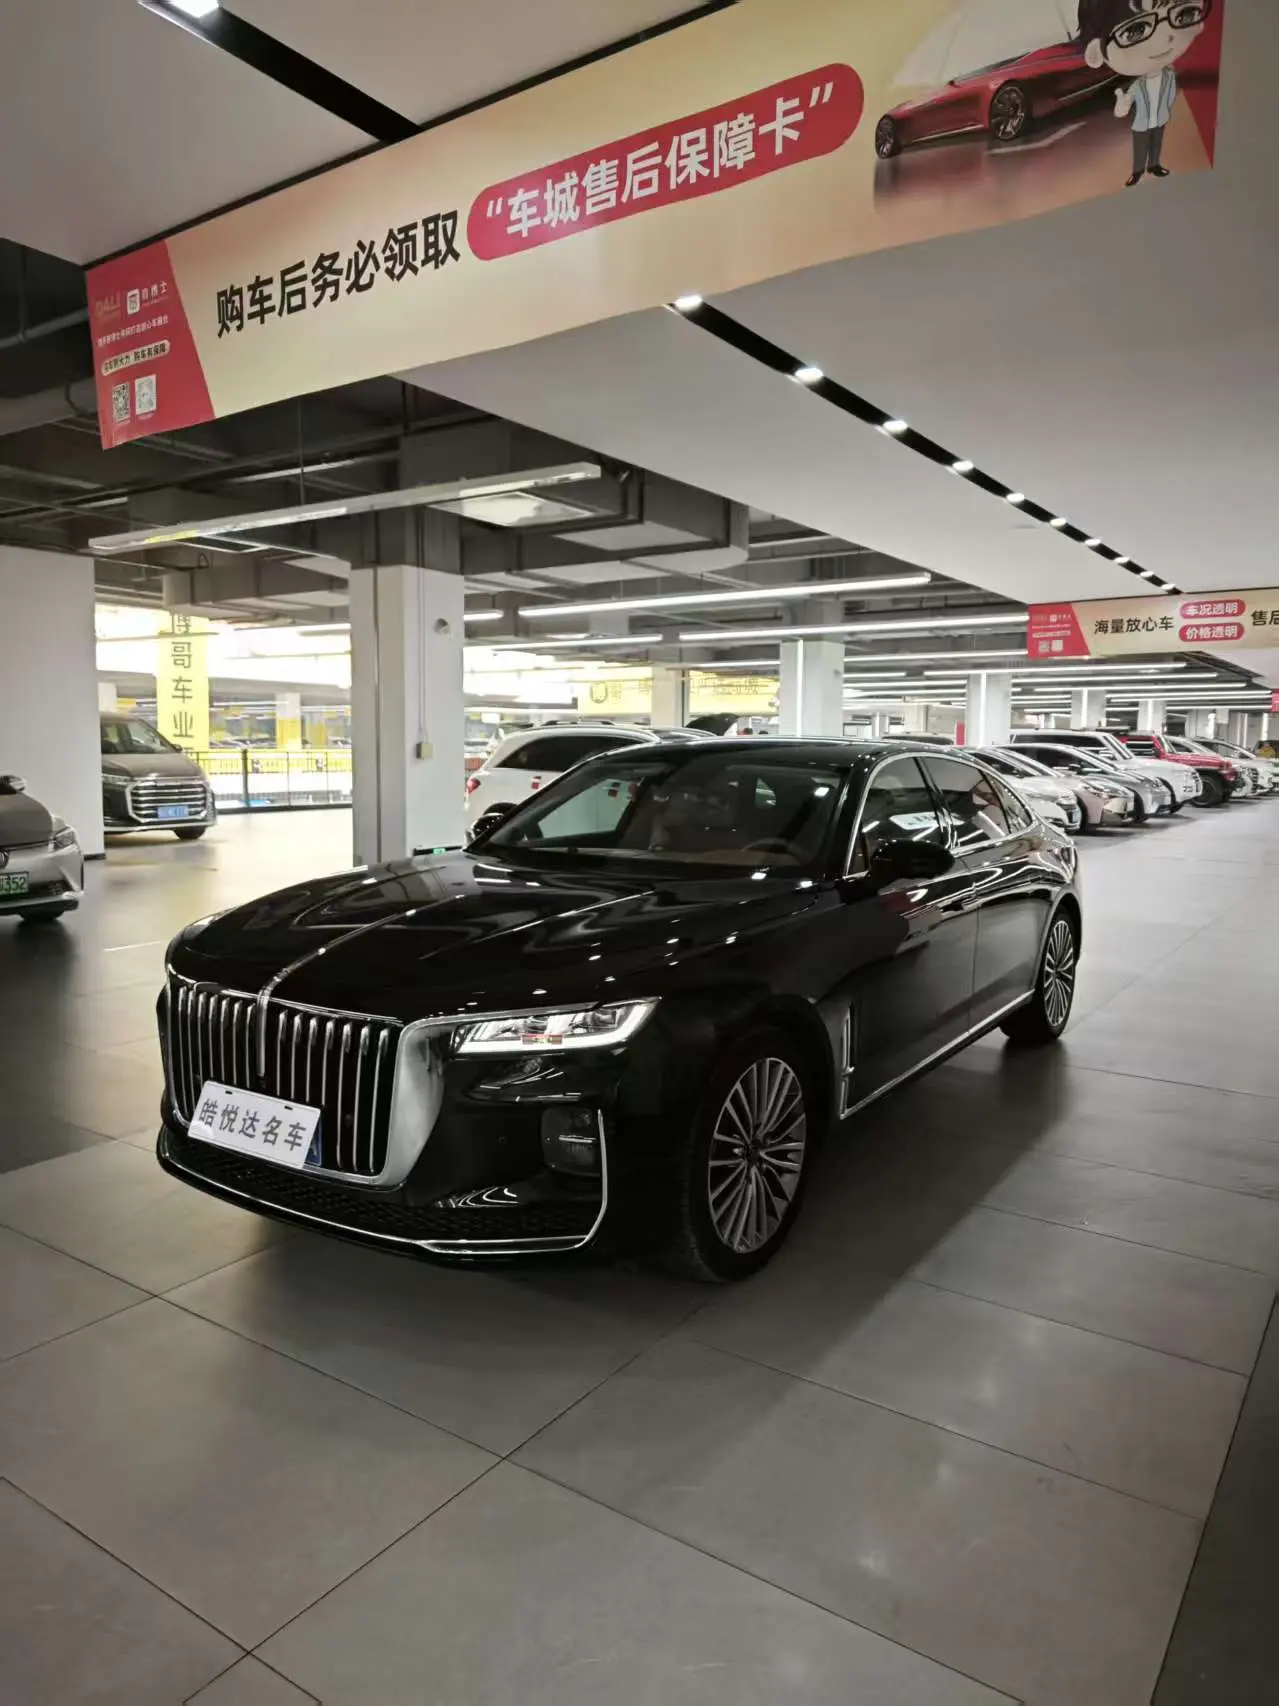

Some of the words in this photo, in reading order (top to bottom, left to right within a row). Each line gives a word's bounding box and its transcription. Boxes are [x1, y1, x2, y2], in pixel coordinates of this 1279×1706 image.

[216, 209, 460, 338] 购车后务必领取
[1185, 602, 1239, 616] 车况透明
[1093, 615, 1175, 634] 海量放心车
[1186, 625, 1239, 639] 价格透明
[198, 1098, 307, 1151] 皓悦达名车
